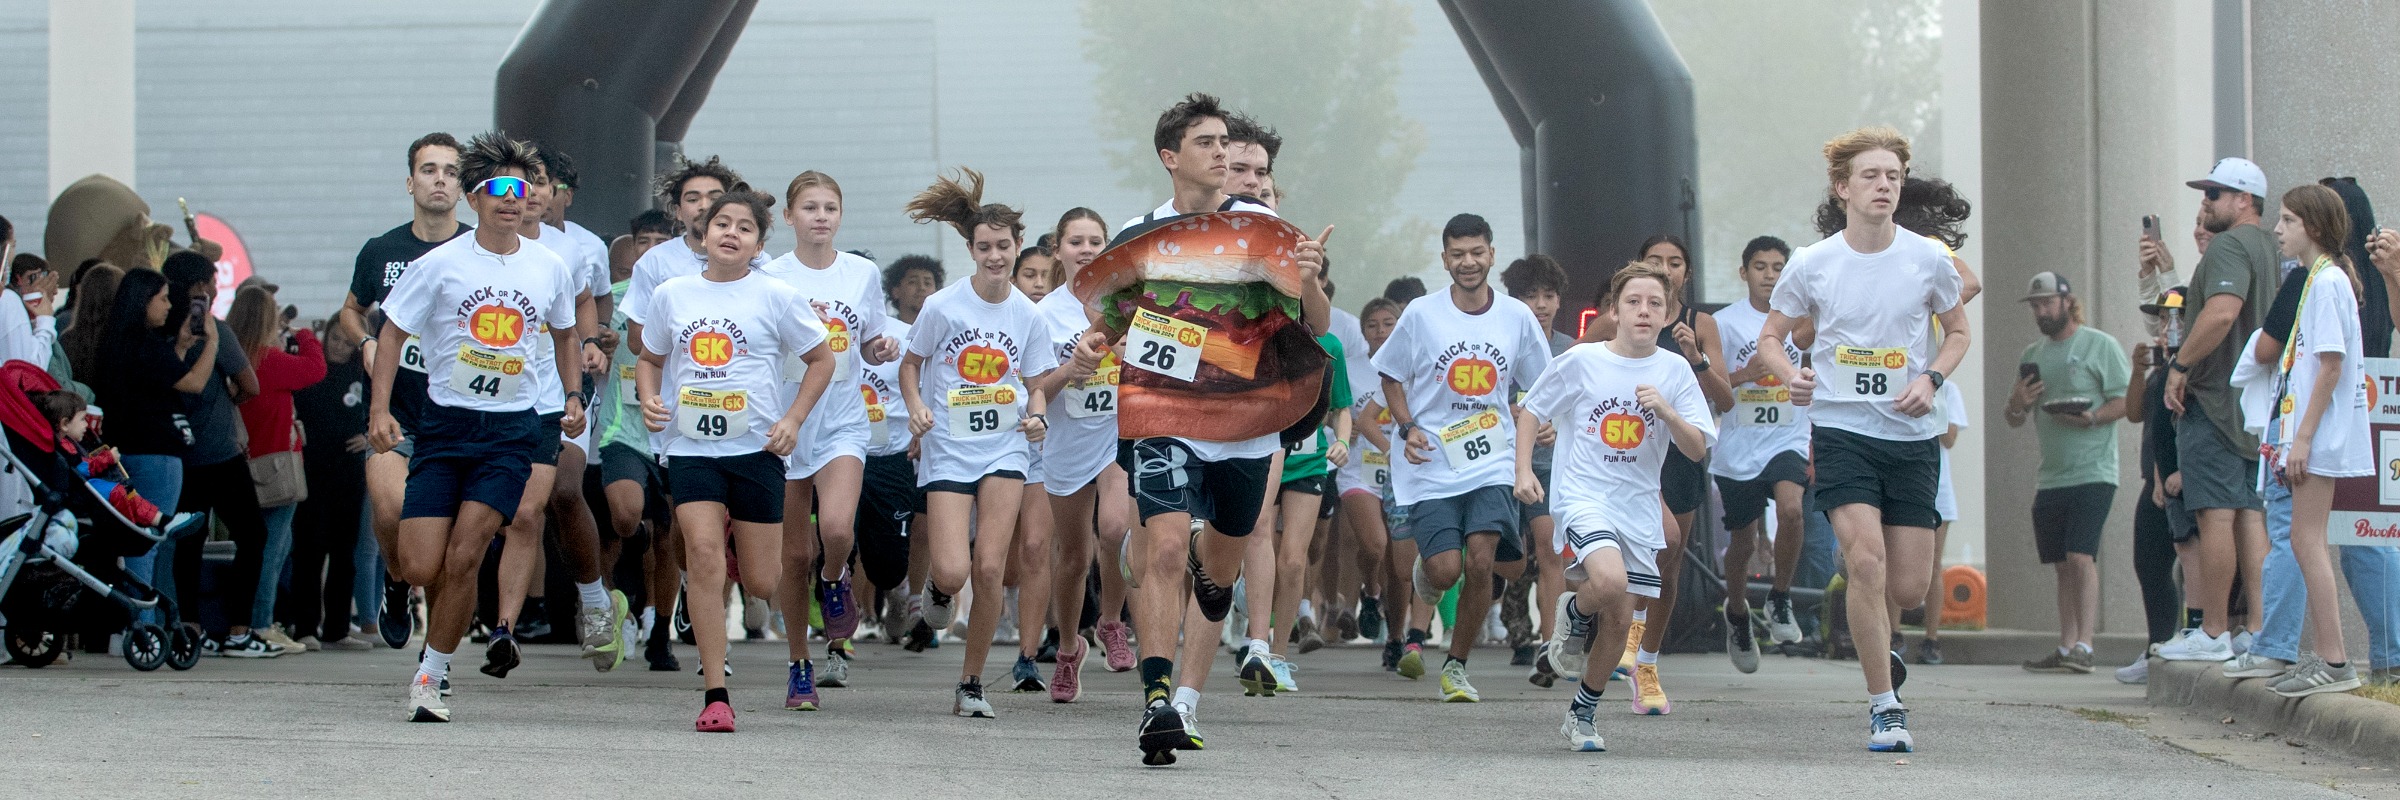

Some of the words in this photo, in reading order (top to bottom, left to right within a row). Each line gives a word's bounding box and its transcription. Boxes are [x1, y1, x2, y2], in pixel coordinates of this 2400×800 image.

[384, 270, 399, 278] TO
[457, 285, 495, 319] TRICK
[512, 289, 538, 324] TROT
[476, 312, 519, 341] 5K
[679, 317, 708, 345] TRICK
[722, 318, 748, 345] TROT
[1135, 315, 1151, 327] TRICK
[1159, 323, 1177, 333] TROT
[695, 337, 730, 362] 5K
[831, 339, 847, 349] 5K
[945, 328, 982, 355] TRICK
[998, 331, 1019, 363] TROT
[1060, 330, 1084, 360] TRIC
[1180, 330, 1199, 346] 5K
[461, 352, 480, 364] TRICK
[486, 359, 502, 367] TROT
[944, 355, 954, 364] 20
[1139, 340, 1177, 370] 26
[1435, 341, 1468, 372] TRICK
[1484, 342, 1508, 373] TROT
[1736, 338, 1759, 363] TRIC
[1783, 341, 1800, 365] ROT
[1839, 353, 1858, 361] TRICK
[1886, 355, 1903, 367] 5K
[504, 363, 520, 374] 5K
[694, 371, 708, 379] FUN
[710, 371, 727, 379] RUN
[963, 352, 1004, 378] 5K
[468, 374, 501, 397] 44
[862, 368, 890, 393] TROT
[1453, 365, 1492, 390] 5K
[1855, 372, 1888, 396] 58
[682, 394, 698, 402] TRICK
[725, 398, 743, 408] 5K
[996, 391, 1013, 403] 5K
[1084, 390, 1113, 413] 42
[1451, 403, 1469, 411] FUN
[1471, 403, 1488, 411] RUN
[969, 409, 999, 432] 59
[1480, 414, 1496, 428] 5K
[1588, 396, 1620, 423] TRICK
[1754, 406, 1779, 424] 20
[696, 414, 728, 437] 49
[1443, 430, 1460, 440] TRICK
[1464, 421, 1478, 432] TROT
[1586, 426, 1596, 434] 20
[1605, 419, 1640, 444] 5K
[1463, 434, 1492, 461] 85
[1603, 454, 1619, 463] FUN
[1621, 455, 1638, 463] RUN
